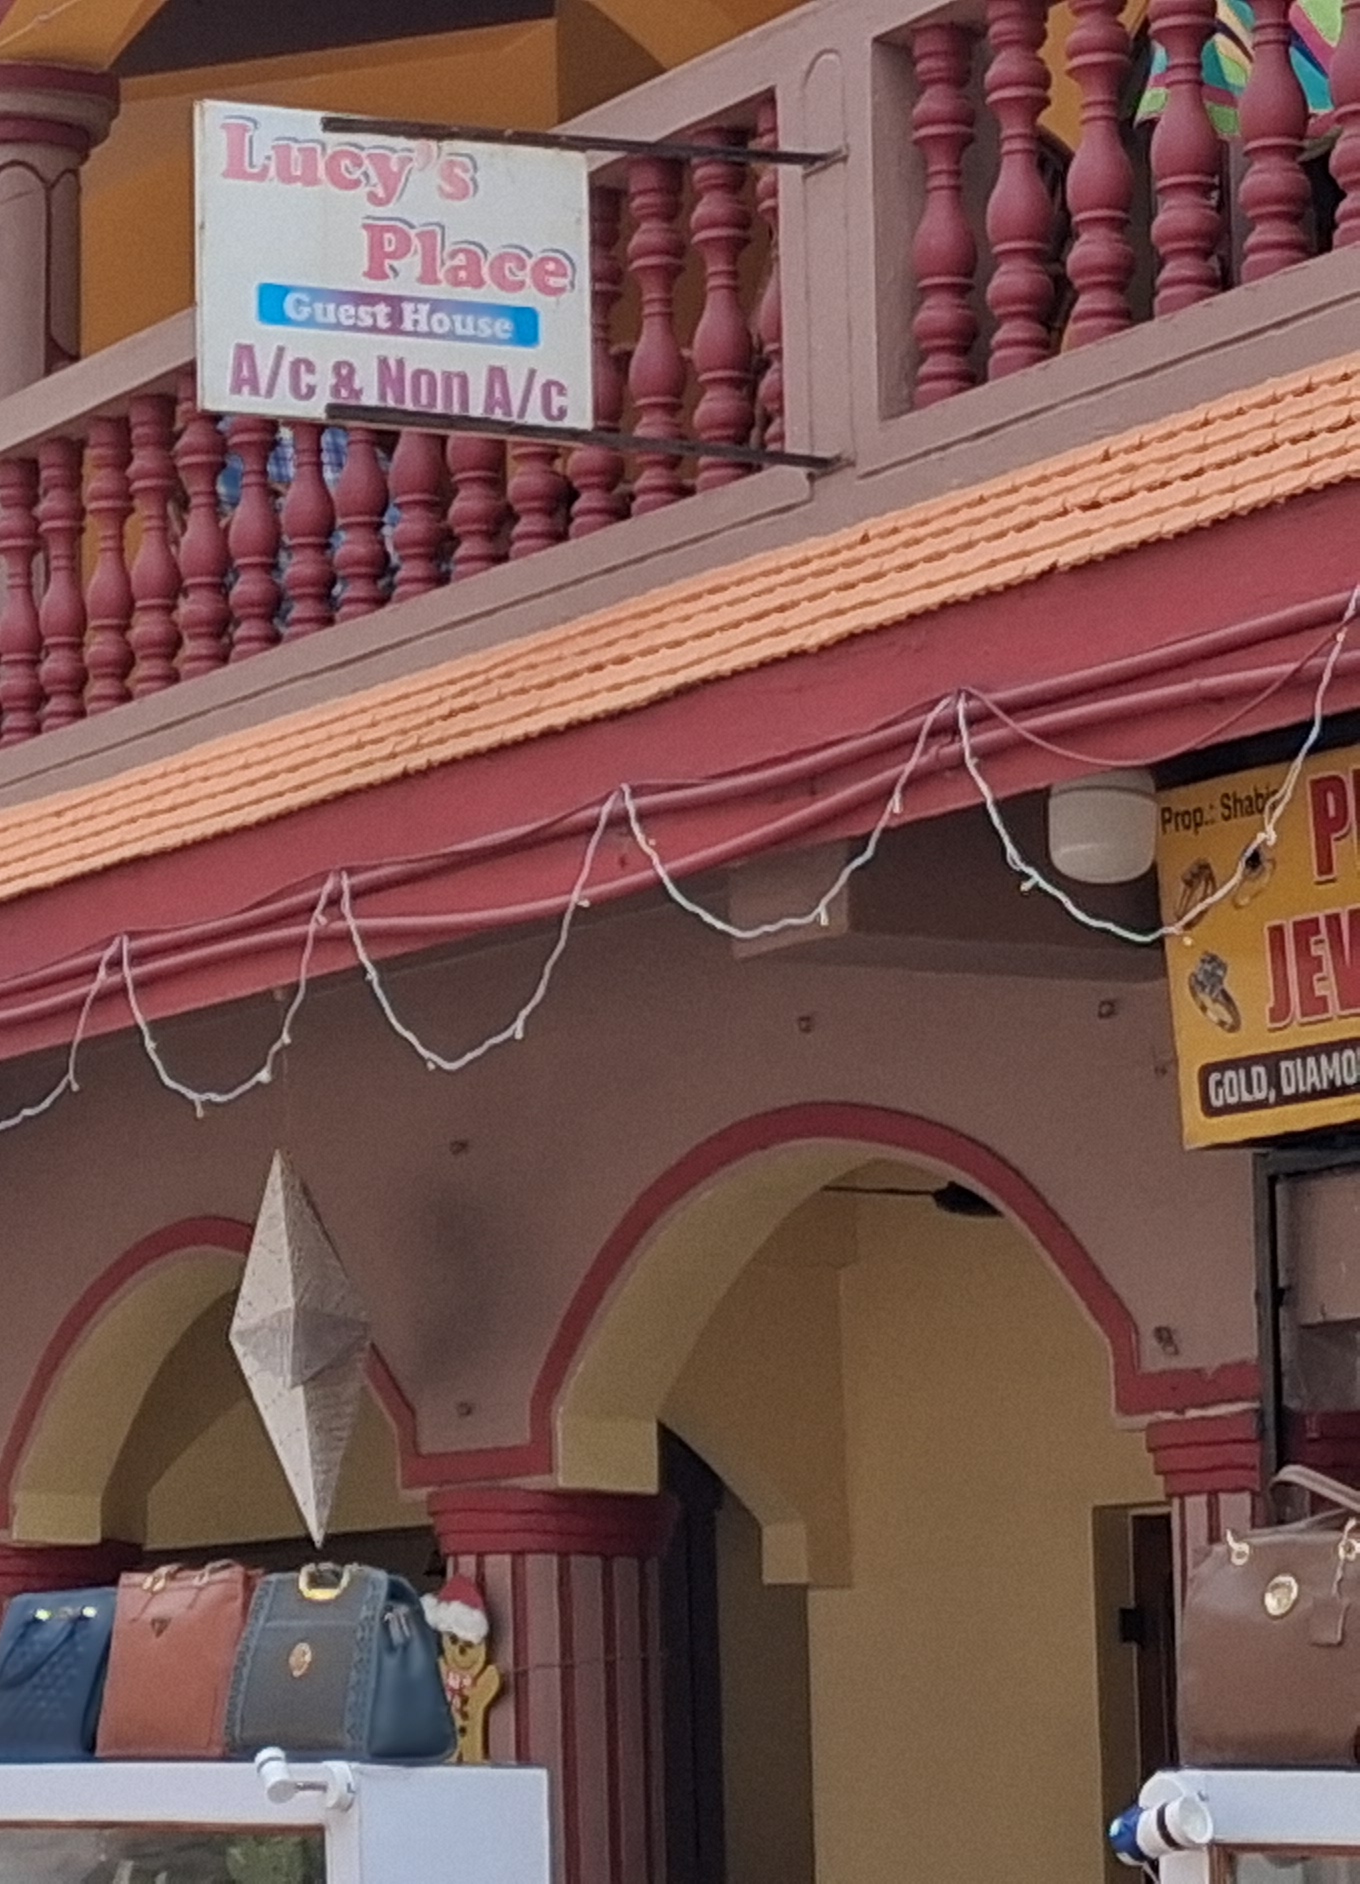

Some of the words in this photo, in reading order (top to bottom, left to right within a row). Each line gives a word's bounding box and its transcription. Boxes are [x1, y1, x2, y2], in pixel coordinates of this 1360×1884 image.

[220, 115, 477, 207] Lucy's
[362, 217, 576, 297] Place
[283, 291, 392, 329] Guest
[401, 301, 513, 340] House
[229, 342, 317, 402] A/c
[330, 358, 364, 403] &
[377, 355, 470, 414] Non
[483, 366, 568, 422] A/c
[1208, 1065, 1276, 1108] GOLD,
[1280, 1048, 1360, 1096] DIAMO
